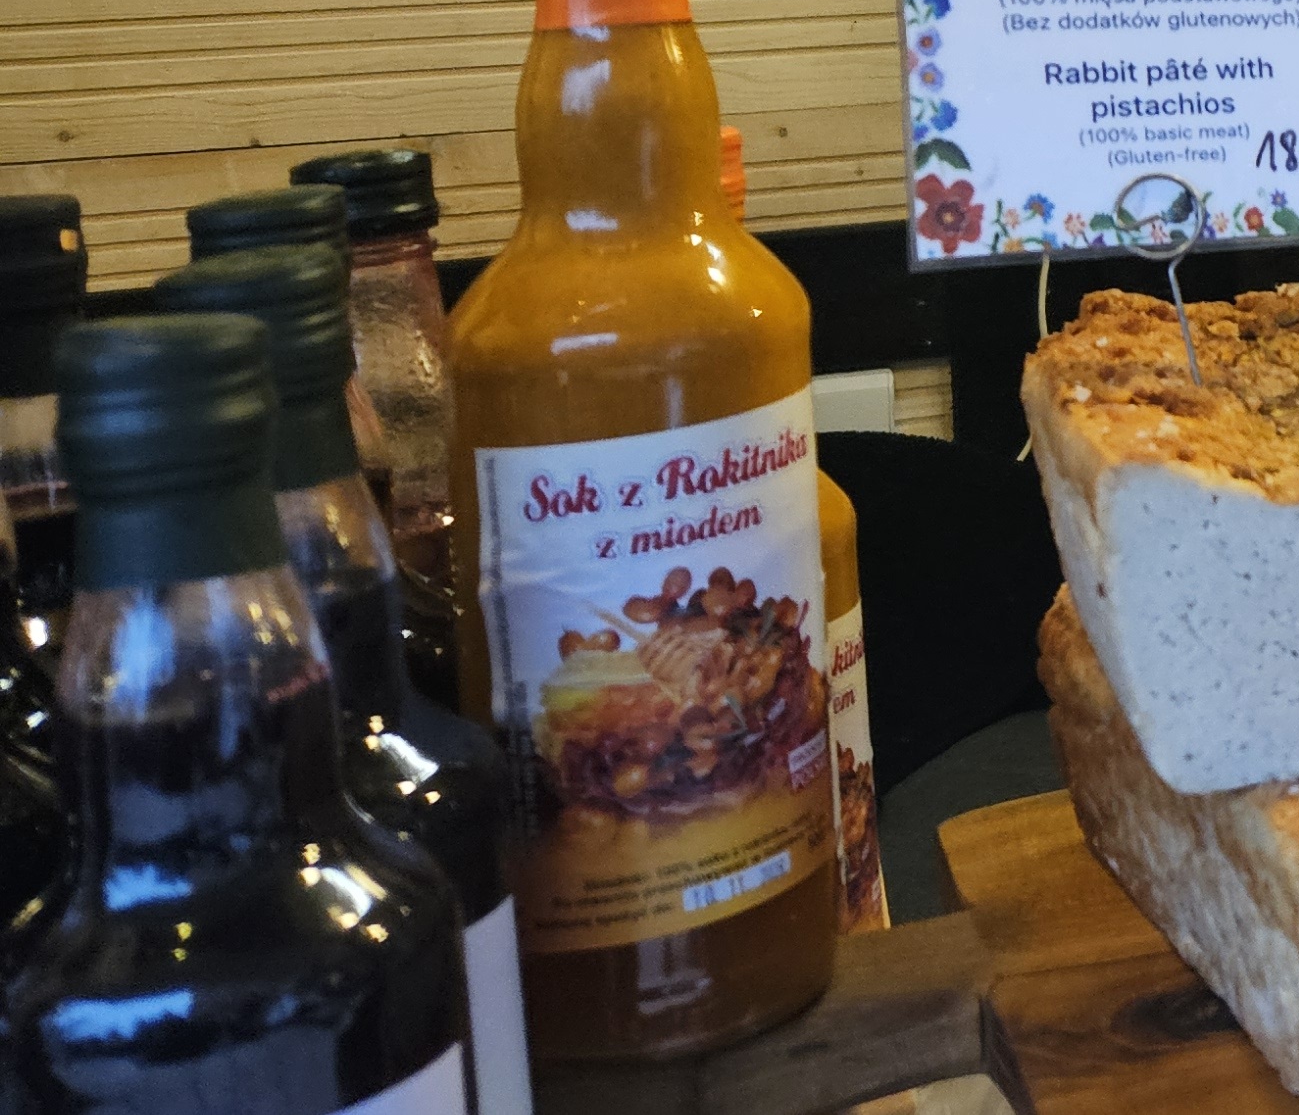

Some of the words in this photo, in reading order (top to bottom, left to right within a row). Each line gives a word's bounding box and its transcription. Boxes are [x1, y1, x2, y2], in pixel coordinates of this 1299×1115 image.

[1003, 13, 1051, 34] (Bez
[1058, 11, 1161, 32] dodatków
[1044, 59, 1138, 85] Rabbit
[1147, 57, 1208, 87] pâté
[1216, 56, 1274, 80] with
[1091, 91, 1236, 123] pistachios
[1079, 126, 1138, 147] (100%
[1144, 123, 1193, 142] basic
[1199, 122, 1250, 142] meat)
[1108, 146, 1227, 168] (Gluten-free)
[523, 474, 600, 522] Sok
[618, 482, 643, 508] z
[595, 537, 617, 559] z
[631, 504, 763, 555] miodem
